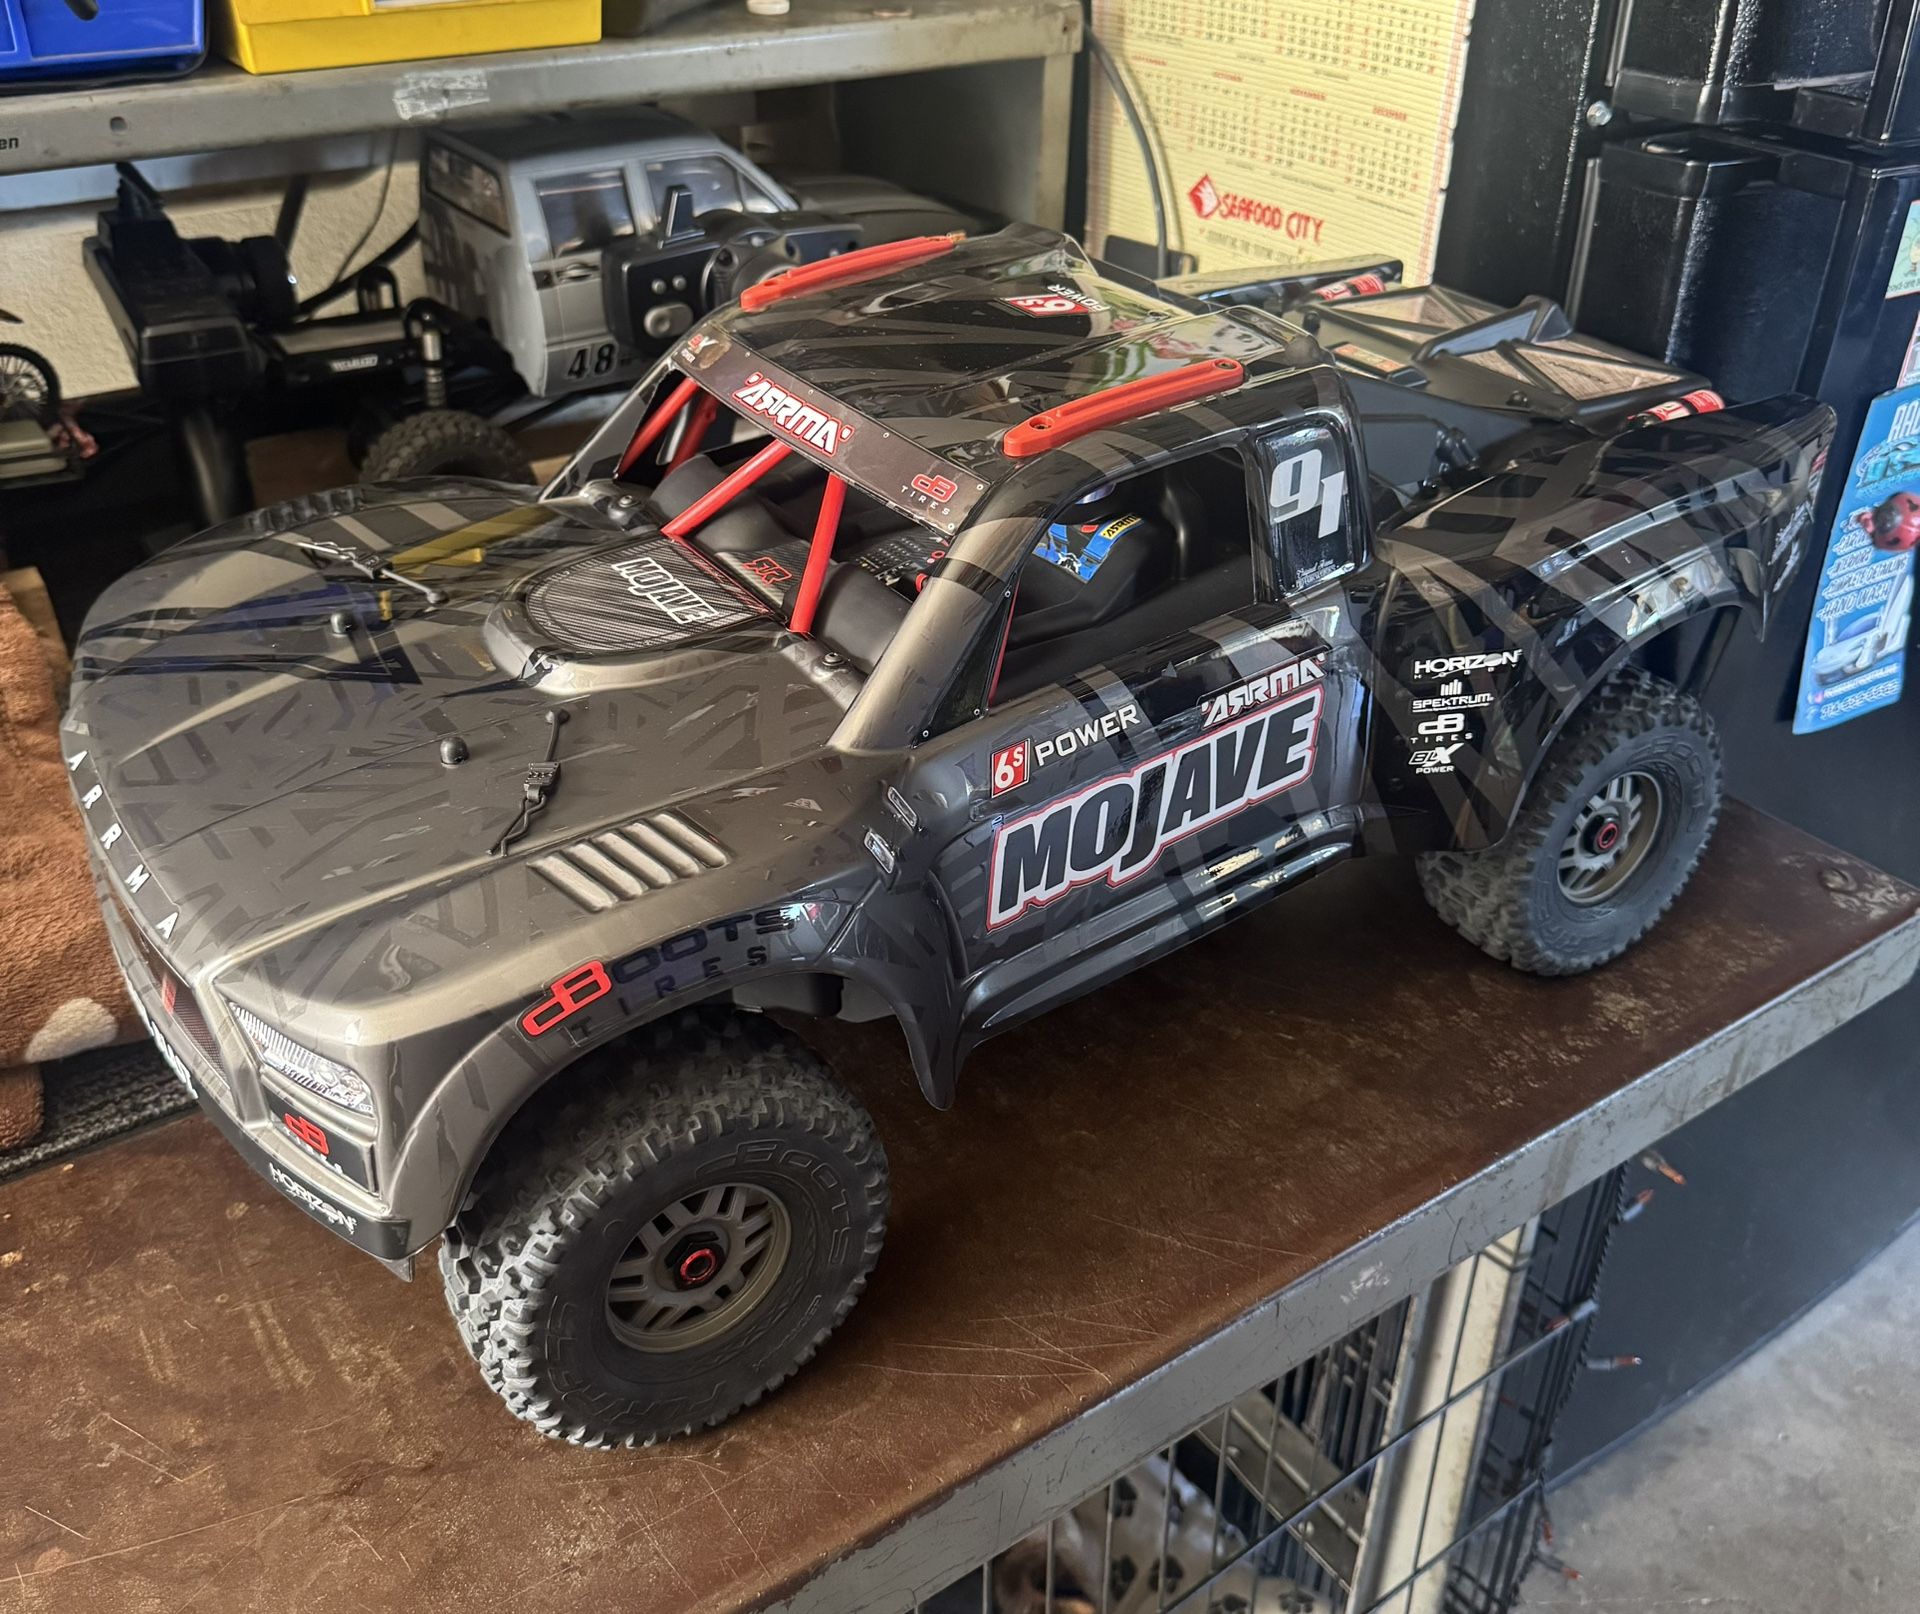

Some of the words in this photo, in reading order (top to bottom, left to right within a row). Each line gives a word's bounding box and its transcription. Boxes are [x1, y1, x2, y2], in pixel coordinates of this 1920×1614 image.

[1219, 193, 1283, 230] SEAFOOD
[1286, 212, 1325, 243] CITY
[1047, 284, 1112, 312] POWER
[567, 343, 616, 379] 48
[901, 485, 950, 515] TIRES
[1270, 449, 1344, 539] 91
[611, 556, 719, 625] MOJAVE
[1820, 595, 1857, 617] HAND
[1857, 585, 1889, 607] WASH
[1413, 649, 1523, 675] HORIZON
[1412, 692, 1491, 711] SPEKTRUM
[1035, 703, 1141, 767] POWER
[1410, 732, 1474, 744] TIRES
[1415, 765, 1454, 775] POWER
[987, 684, 1325, 932] MOJAVE
[269, 1162, 357, 1234] HORIZON
